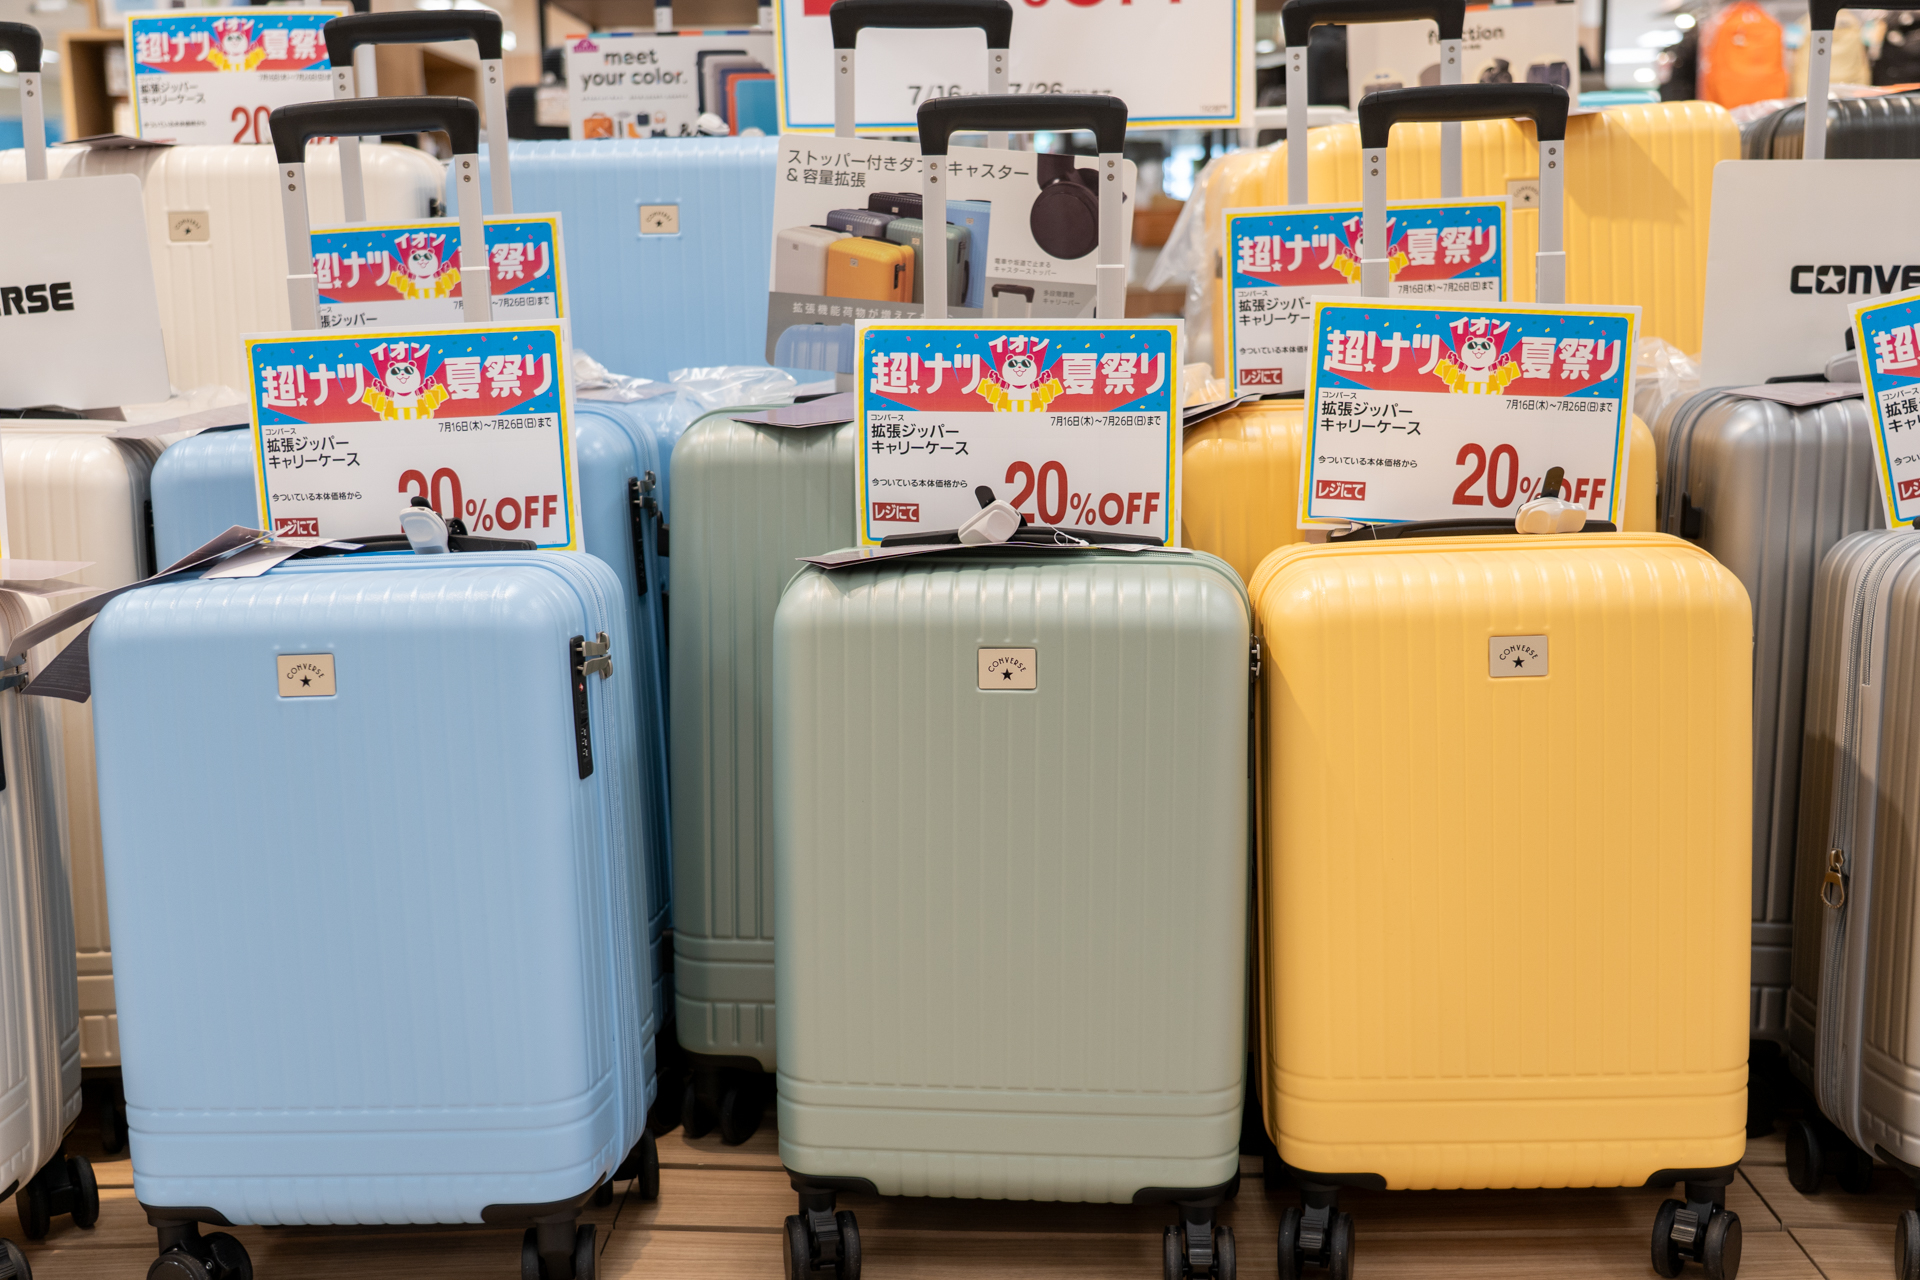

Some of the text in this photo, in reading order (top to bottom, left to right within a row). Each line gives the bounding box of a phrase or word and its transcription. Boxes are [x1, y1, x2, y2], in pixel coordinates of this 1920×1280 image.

[211, 16, 256, 32] イオン
[1428, 24, 1505, 46] fction
[603, 49, 659, 66] meet
[581, 68, 689, 92] your color.
[787, 149, 1030, 181] ストッパー付きダキャスター
[786, 167, 866, 189] & 容量拡張
[394, 231, 447, 250] イオン
[1406, 225, 1497, 266] 夏祭り
[1238, 290, 1269, 298] コンバース
[792, 301, 954, 319] 拡張機能荷物が増えて
[320, 312, 378, 329] 張ジッパー
[1238, 312, 1310, 327] キャリーケー
[1449, 316, 1512, 336] イオン
[369, 341, 431, 361] イオン
[988, 334, 1050, 353] イオン
[1239, 345, 1308, 355] 今ついている本体価
[1520, 336, 1622, 381] 夏祭り
[443, 352, 553, 400] 夏祭り
[1061, 352, 1166, 395] 夏祭り
[1241, 370, 1282, 384] レジにて
[1322, 391, 1358, 399] コンバース
[1882, 387, 1920, 402] コンバース
[1321, 400, 1413, 418] 拡張ジッパー
[1885, 397, 1920, 418] 拡張
[870, 413, 905, 422] コンバース
[265, 428, 297, 436] コンバース
[871, 423, 959, 439] 拡張ジッパー
[1320, 417, 1421, 436] キャリーケース
[266, 434, 350, 454] 拡張ジッパー
[871, 440, 969, 455] キャリーケース
[268, 452, 361, 469] キャリーケース
[1318, 455, 1418, 468] 今ついている本体価格から
[872, 477, 968, 489] 今ついている本体価格から
[1317, 481, 1364, 499] レジにて
[272, 491, 363, 503] 今ついている本体価格から
[874, 504, 918, 521] レジにて
[1499, 644, 1539, 661] CONVERSE
[286, 662, 326, 680] CONVERSE
[987, 656, 1027, 673] CONVERSE
